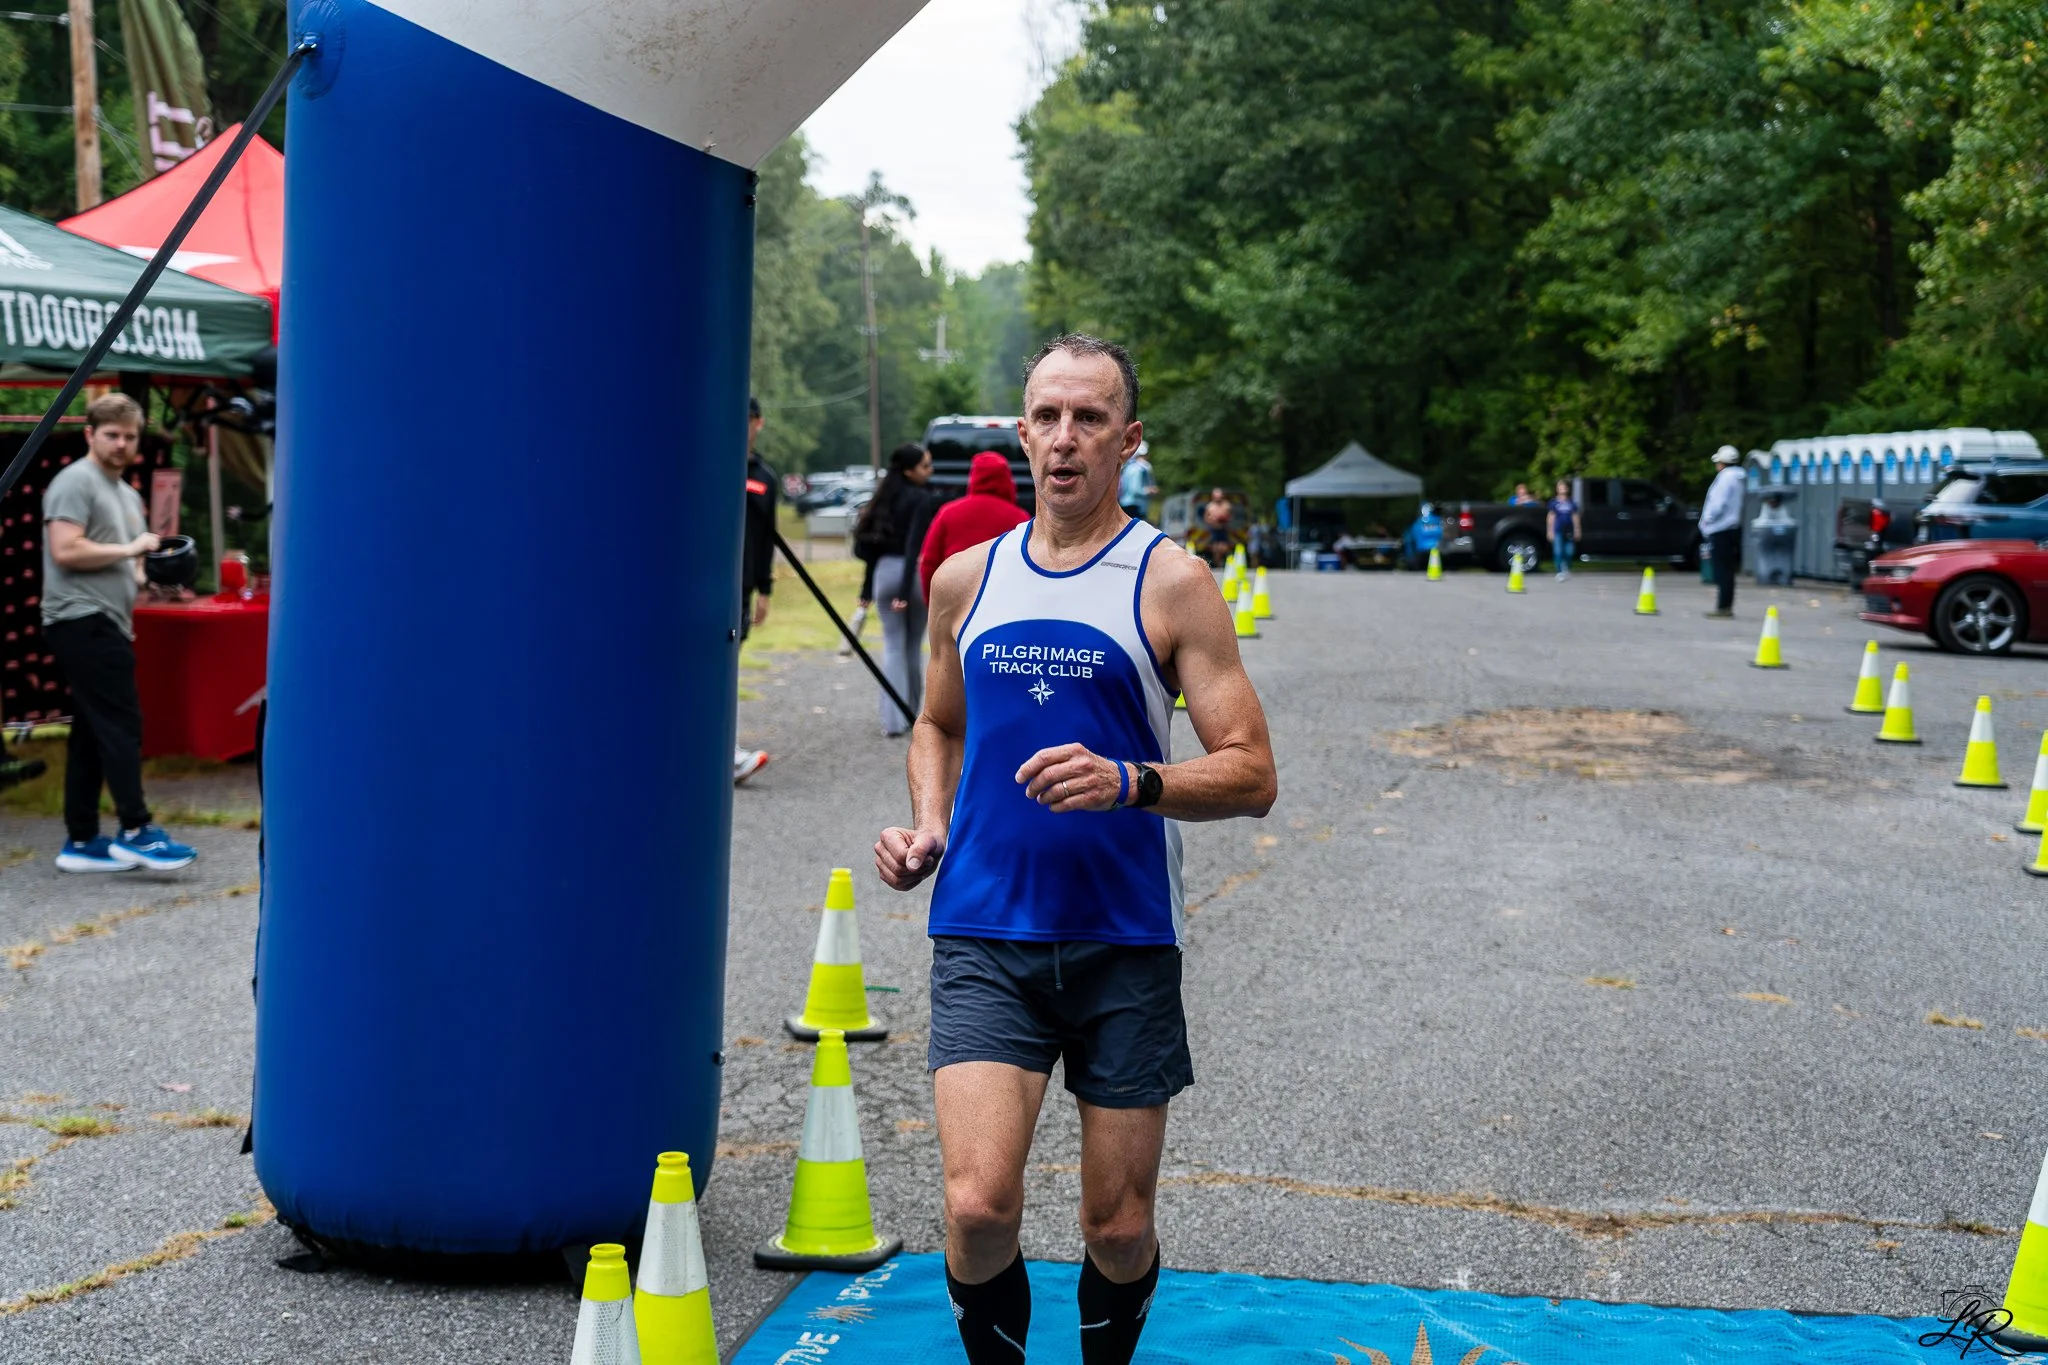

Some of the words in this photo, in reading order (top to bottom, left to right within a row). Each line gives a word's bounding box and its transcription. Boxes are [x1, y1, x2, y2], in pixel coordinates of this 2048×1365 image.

[981, 643, 1106, 666] PILGRIMAGE
[989, 661, 1044, 676] TRACK
[1048, 664, 1093, 679] CLUB
